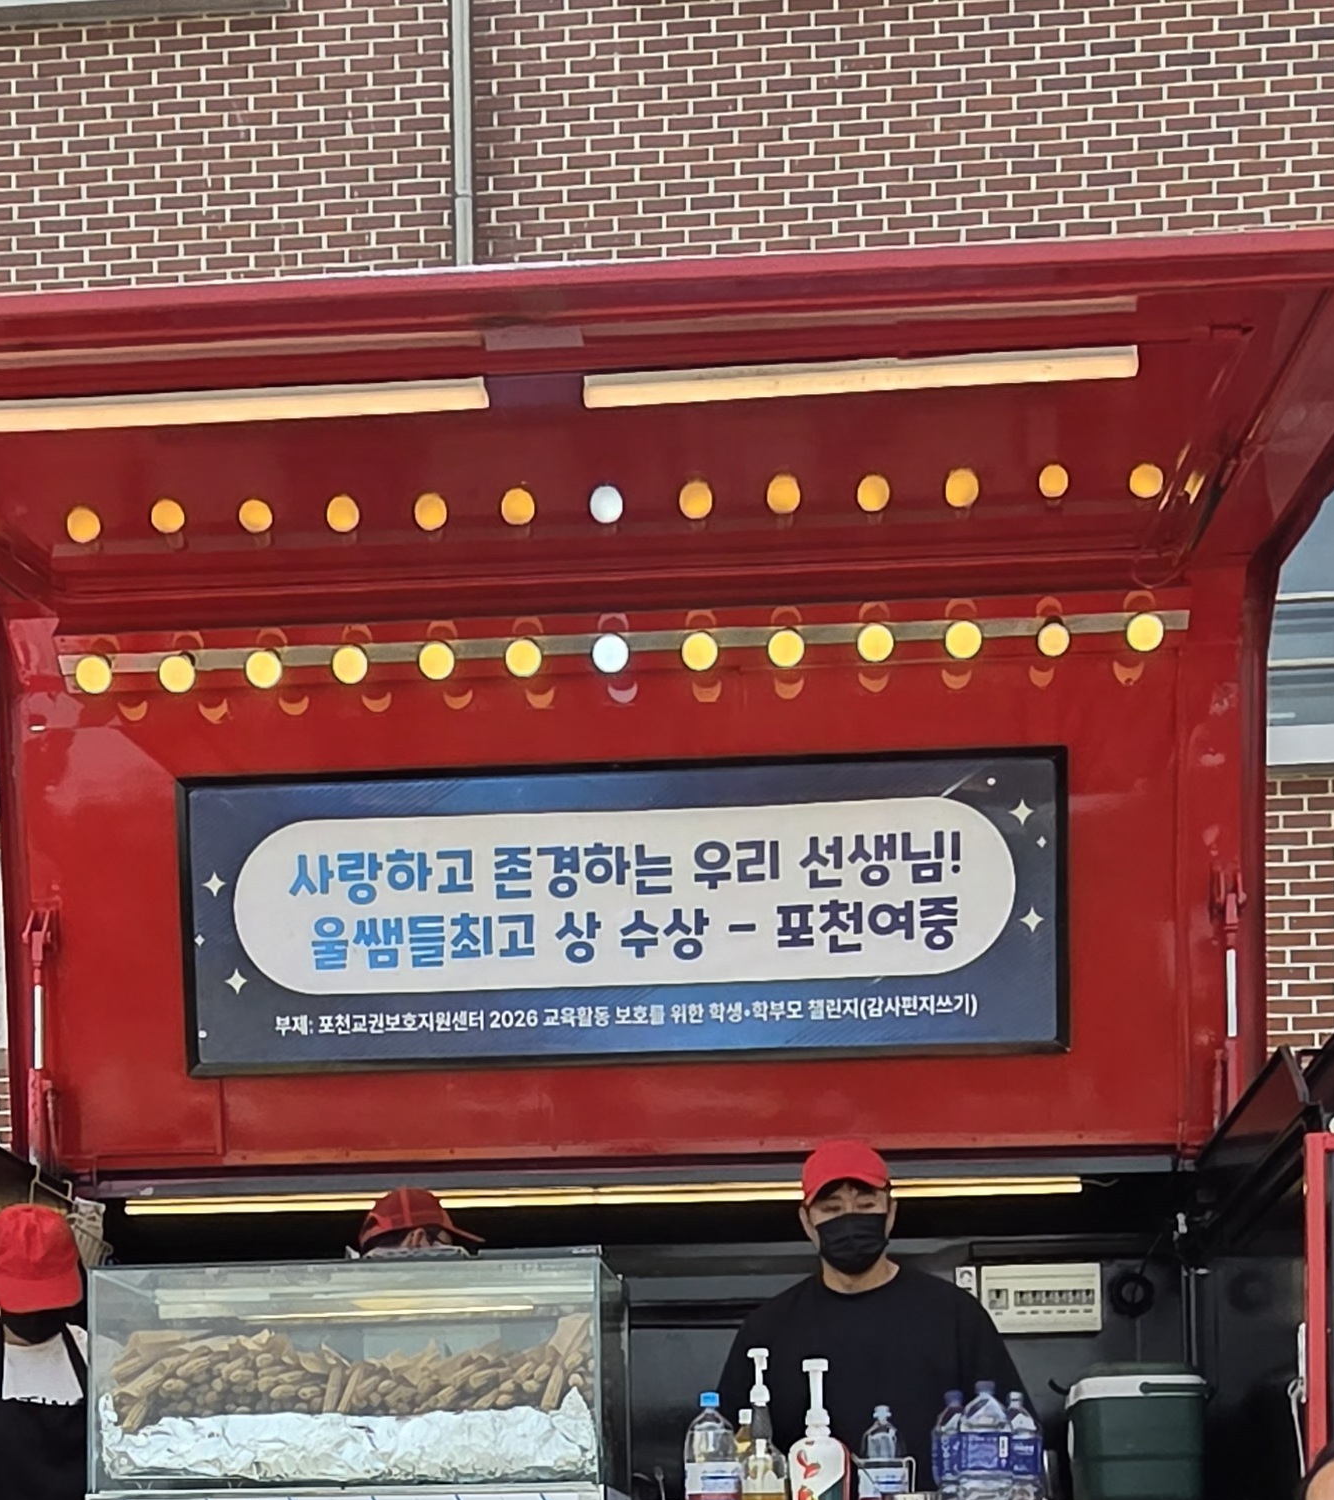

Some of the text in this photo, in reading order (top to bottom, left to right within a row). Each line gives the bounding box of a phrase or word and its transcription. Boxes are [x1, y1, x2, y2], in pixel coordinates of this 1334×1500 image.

[289, 830, 961, 905] 사랑하고 존경하는 우리 선생님!
[312, 912, 535, 971] 울쌤들최고
[555, 911, 601, 964] 상
[620, 909, 709, 961] 수상
[776, 896, 958, 955] 포천여중
[275, 1013, 315, 1037] 부제:
[318, 1009, 485, 1034] 포천교권보호지원센터
[489, 1009, 539, 1030] 2026
[542, 1005, 610, 1028] 교육활동
[615, 1003, 665, 1026] 보호를
[670, 1003, 705, 1025] 위한
[808, 993, 979, 1021] 챌린지(감사편지쓰기)
